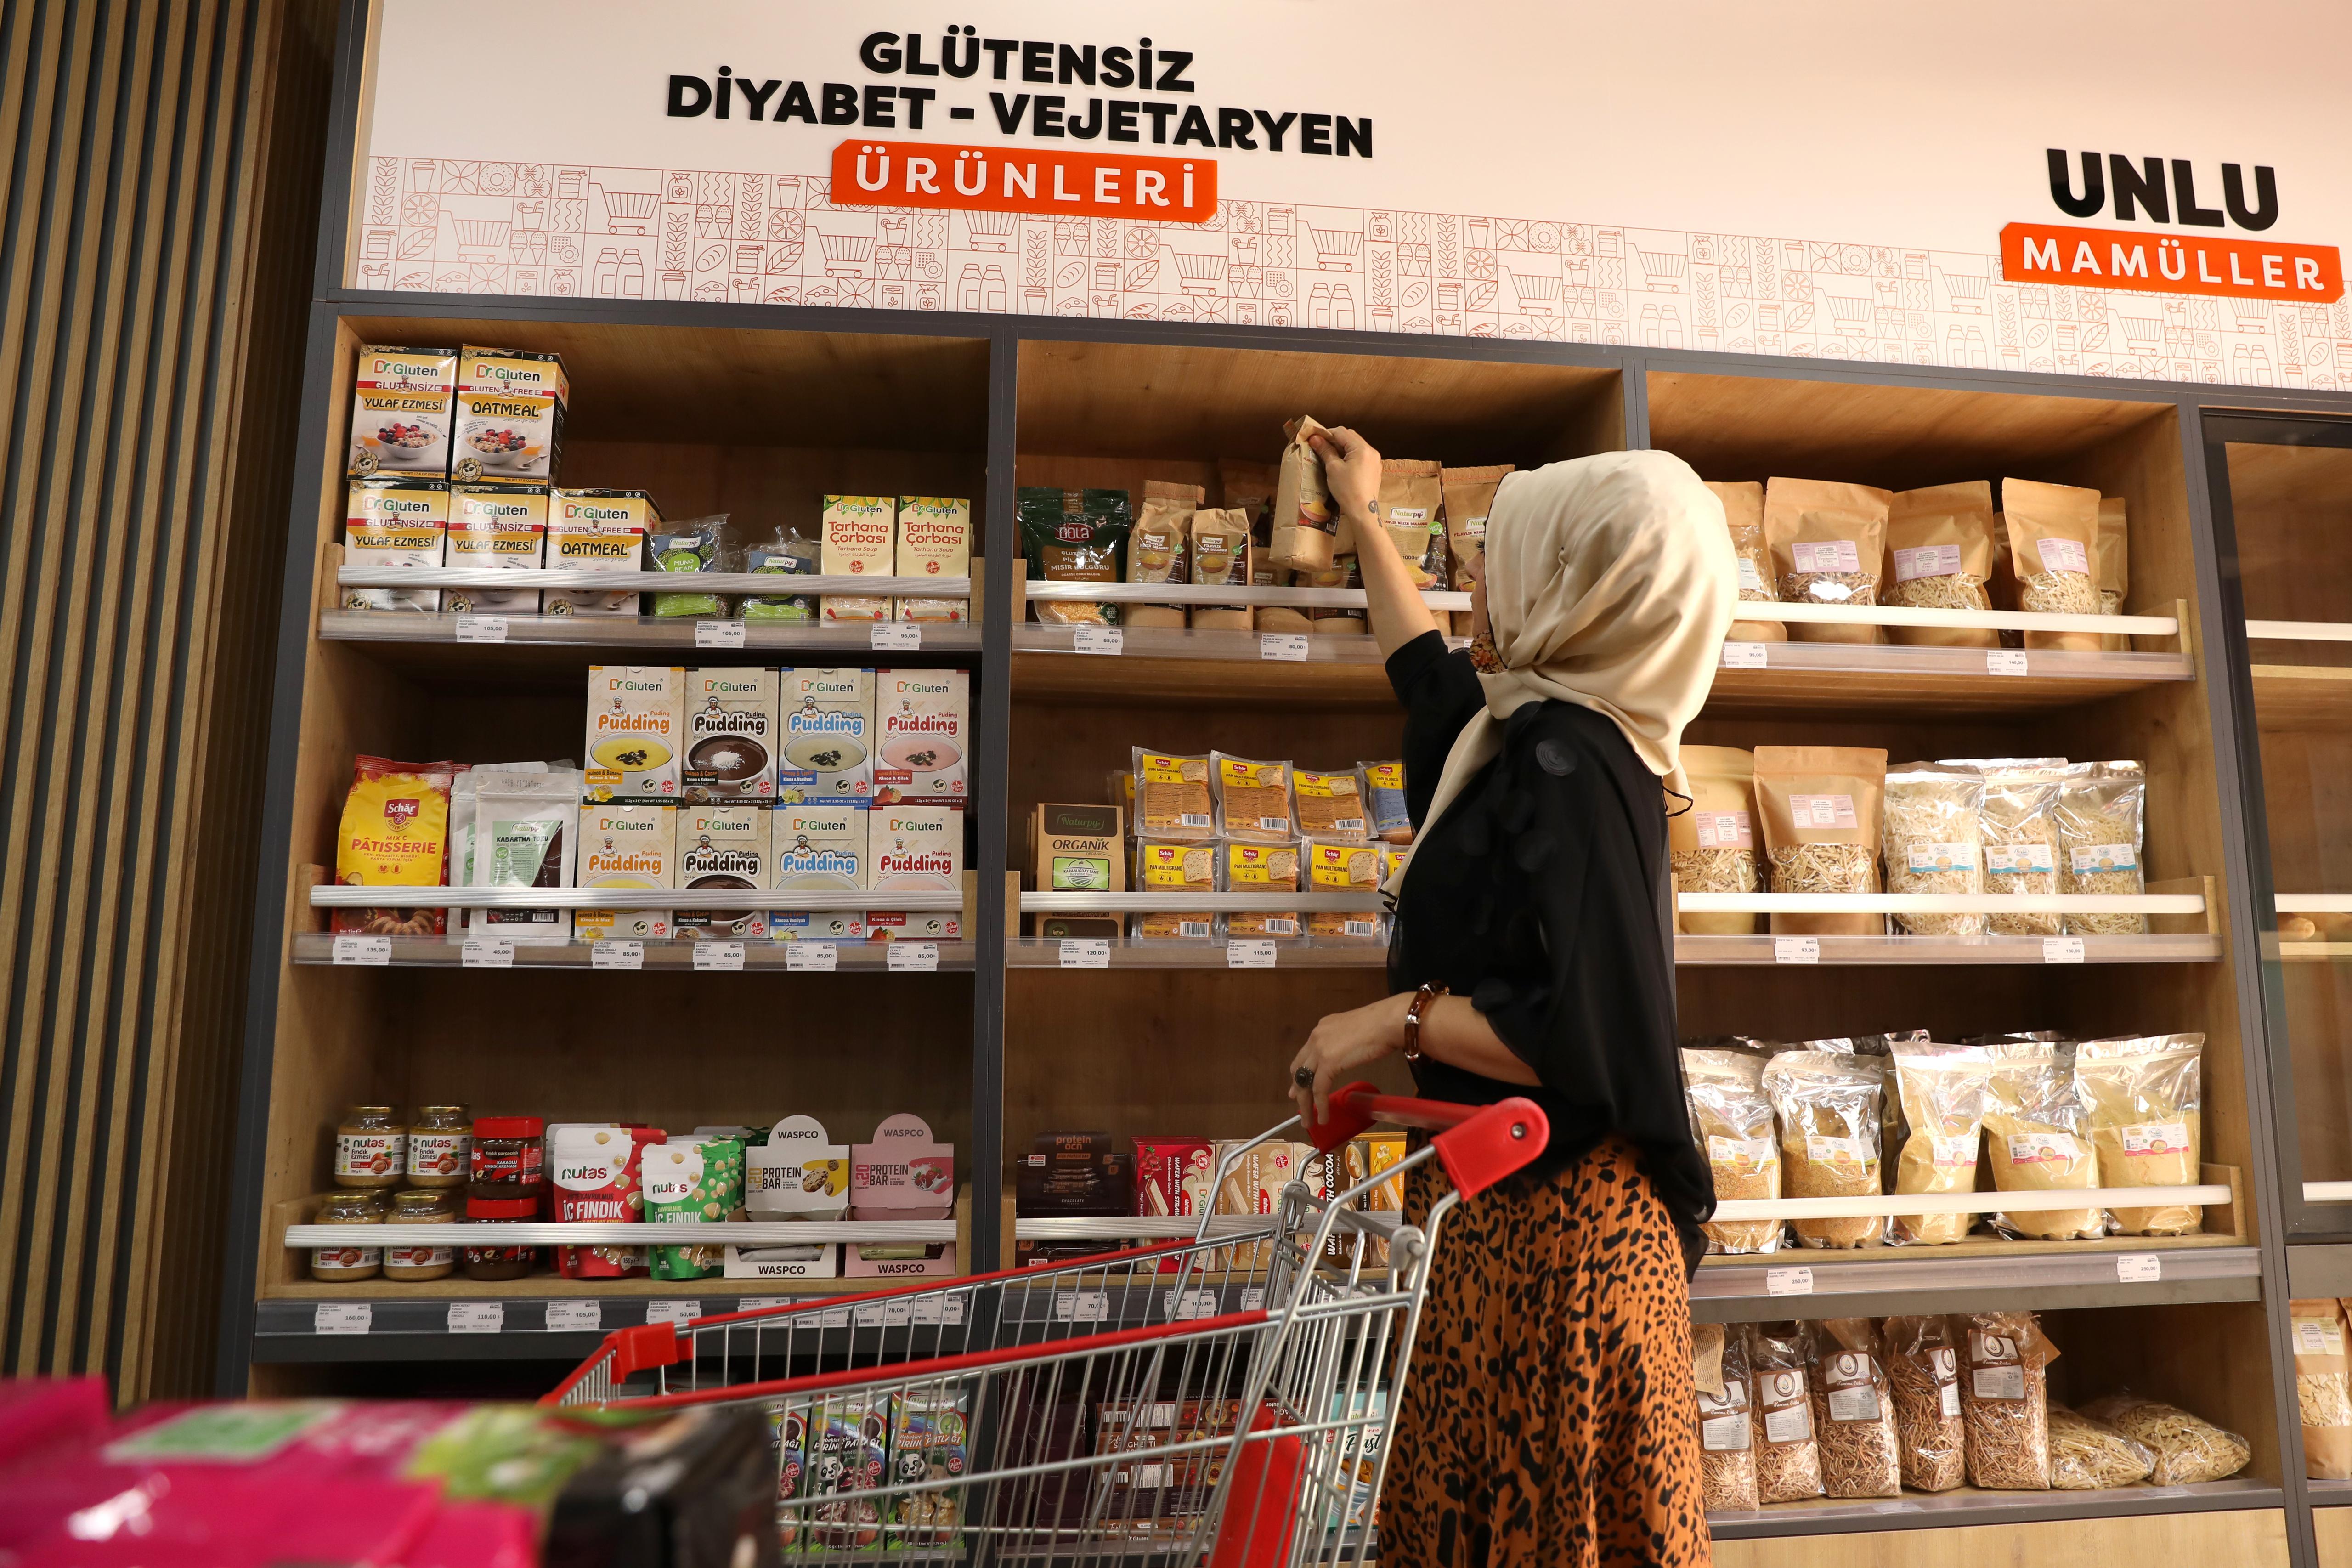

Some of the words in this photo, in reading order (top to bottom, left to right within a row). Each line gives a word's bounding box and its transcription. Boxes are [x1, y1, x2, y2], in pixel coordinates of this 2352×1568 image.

[860, 24, 1195, 92] GLÜTENSİZ
[667, 66, 935, 129] DİYABET
[989, 92, 1373, 158] VEJETARYEN
[855, 145, 1195, 208] ÜRÜNLERİ
[2047, 148, 2278, 232] UNLU
[2024, 237, 2325, 291] MAMÜLLER
[393, 362, 438, 376] Gluten
[495, 368, 540, 382] Gluten
[365, 398, 399, 408] YULAF
[402, 398, 443, 410] EZMESİ
[472, 402, 539, 417] OATMEAL
[384, 499, 430, 512] Gluten
[483, 503, 527, 516] Gluten
[850, 504, 882, 514] Gluten
[926, 505, 957, 515] Gluten
[583, 507, 628, 520] Gluten
[1394, 509, 1424, 518] Naturpy
[828, 521, 889, 534] Tarhana
[904, 521, 964, 535] Tarhana
[356, 536, 390, 547] YULAF
[394, 536, 435, 548] EZMESİ
[672, 538, 700, 549] Naturpy
[830, 532, 886, 545] Çorbası
[905, 532, 962, 546] Çorbası
[456, 540, 491, 551] YULAF
[493, 539, 533, 552] EZMESİ
[561, 542, 628, 556] OATMEAL
[768, 557, 795, 568] Naturpy
[625, 679, 662, 691] Gluten
[720, 681, 757, 692] Gluten
[817, 681, 853, 692] Gluten
[912, 682, 948, 693] Gluten
[599, 714, 670, 734] Pudding
[695, 716, 765, 736] Pudding
[791, 715, 862, 736] Pudding
[888, 716, 957, 736] Pudding
[388, 803, 416, 815] Schär
[388, 819, 413, 830] GLUTEN-FREE
[616, 821, 654, 831] Gluten
[712, 821, 749, 831] Gluten
[808, 821, 846, 831] Gluten
[906, 821, 942, 831] Gluten
[351, 837, 436, 855] PÂTISSERIE
[589, 855, 662, 875] Pudding
[686, 856, 758, 875] Pudding
[784, 856, 855, 875] Pudding
[881, 855, 951, 875] Pudding
[778, 1131, 818, 1139] WASPCO
[1056, 1135, 1091, 1145] protein
[353, 1139, 384, 1148] nutas
[421, 1139, 451, 1148] nutas
[562, 1166, 607, 1180] nutas
[763, 1167, 801, 1178] PROTEIN
[870, 1164, 908, 1175] PROTEIN
[1326, 1154, 1334, 1189] COCOA
[762, 1178, 780, 1189] BAR
[870, 1175, 888, 1185] BAR
[652, 1183, 687, 1194] nutas
[577, 1200, 623, 1219] FINDIK
[666, 1212, 701, 1223] FINDIK
[758, 1265, 806, 1274] WASPCO
[878, 1264, 925, 1273] WASPCO
